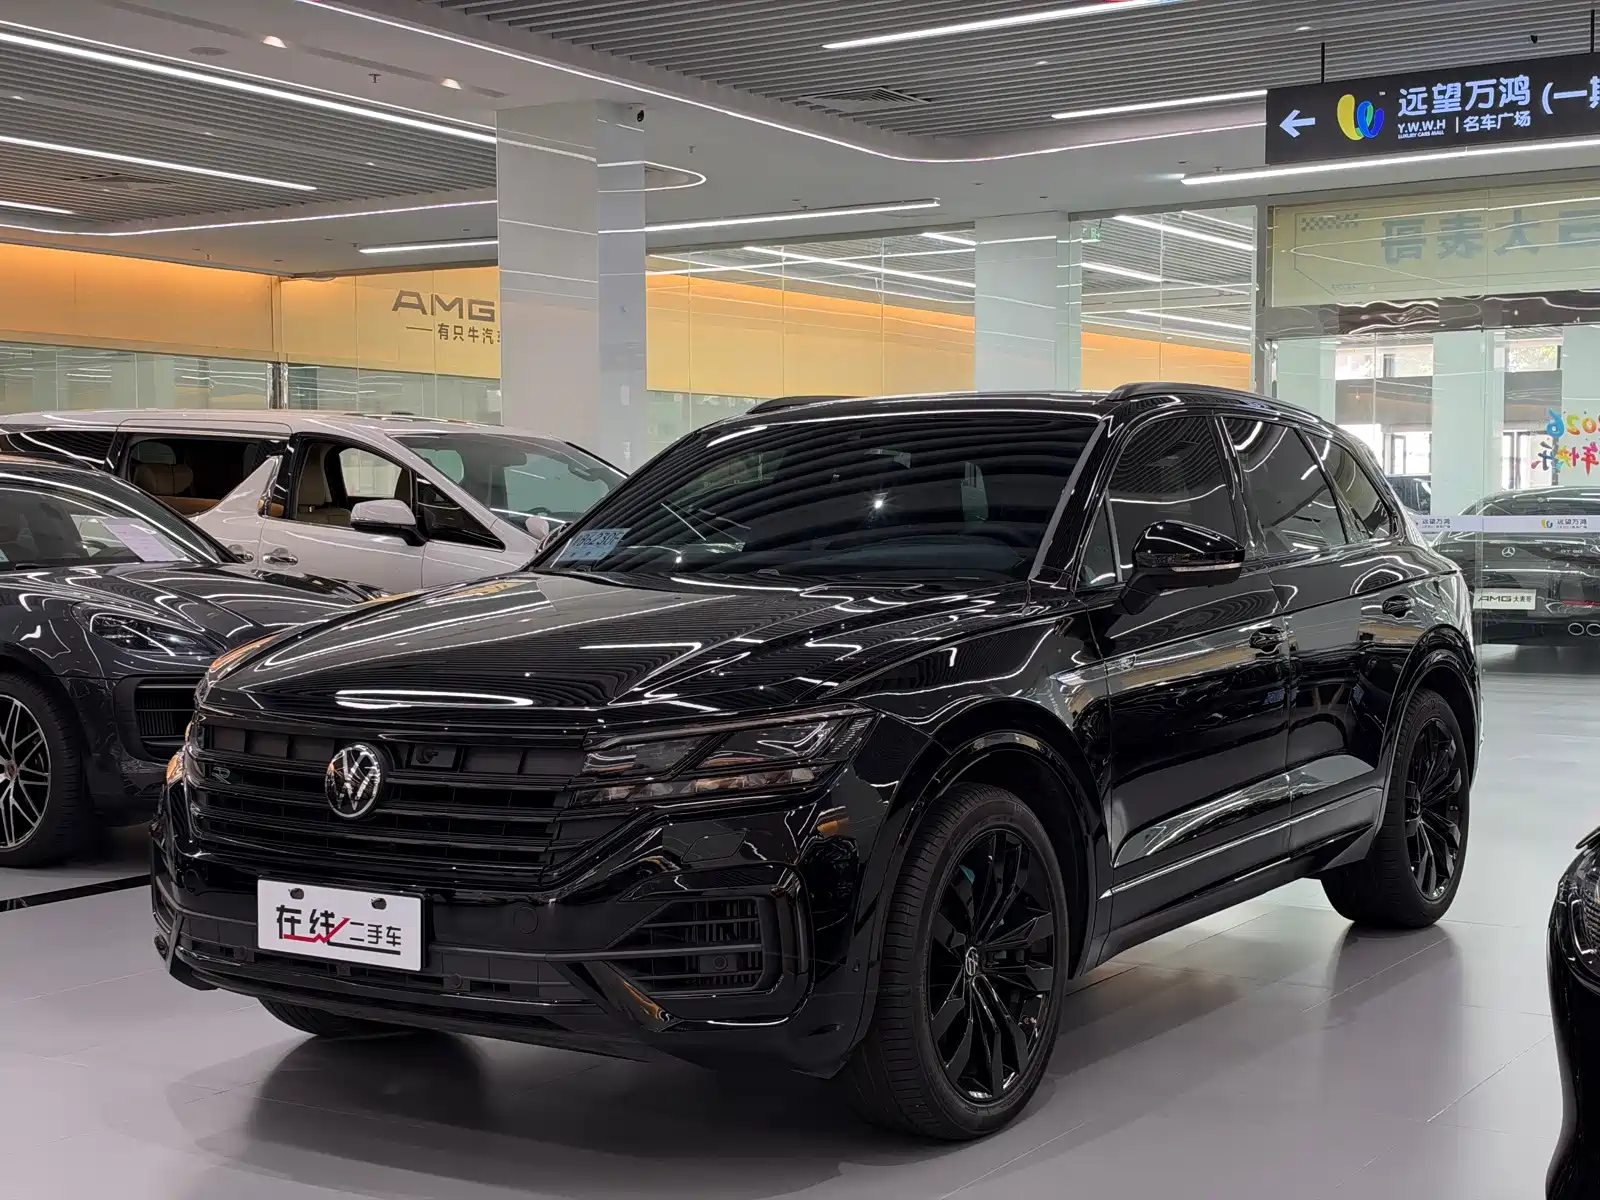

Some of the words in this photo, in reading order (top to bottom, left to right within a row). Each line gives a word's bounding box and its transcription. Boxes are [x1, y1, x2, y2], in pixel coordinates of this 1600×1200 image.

[1397, 119, 1446, 133] Y.W.W.H
[1463, 111, 1531, 132] 名车广场
[391, 290, 495, 322] AMG
[437, 322, 500, 345] 有只牛汽
